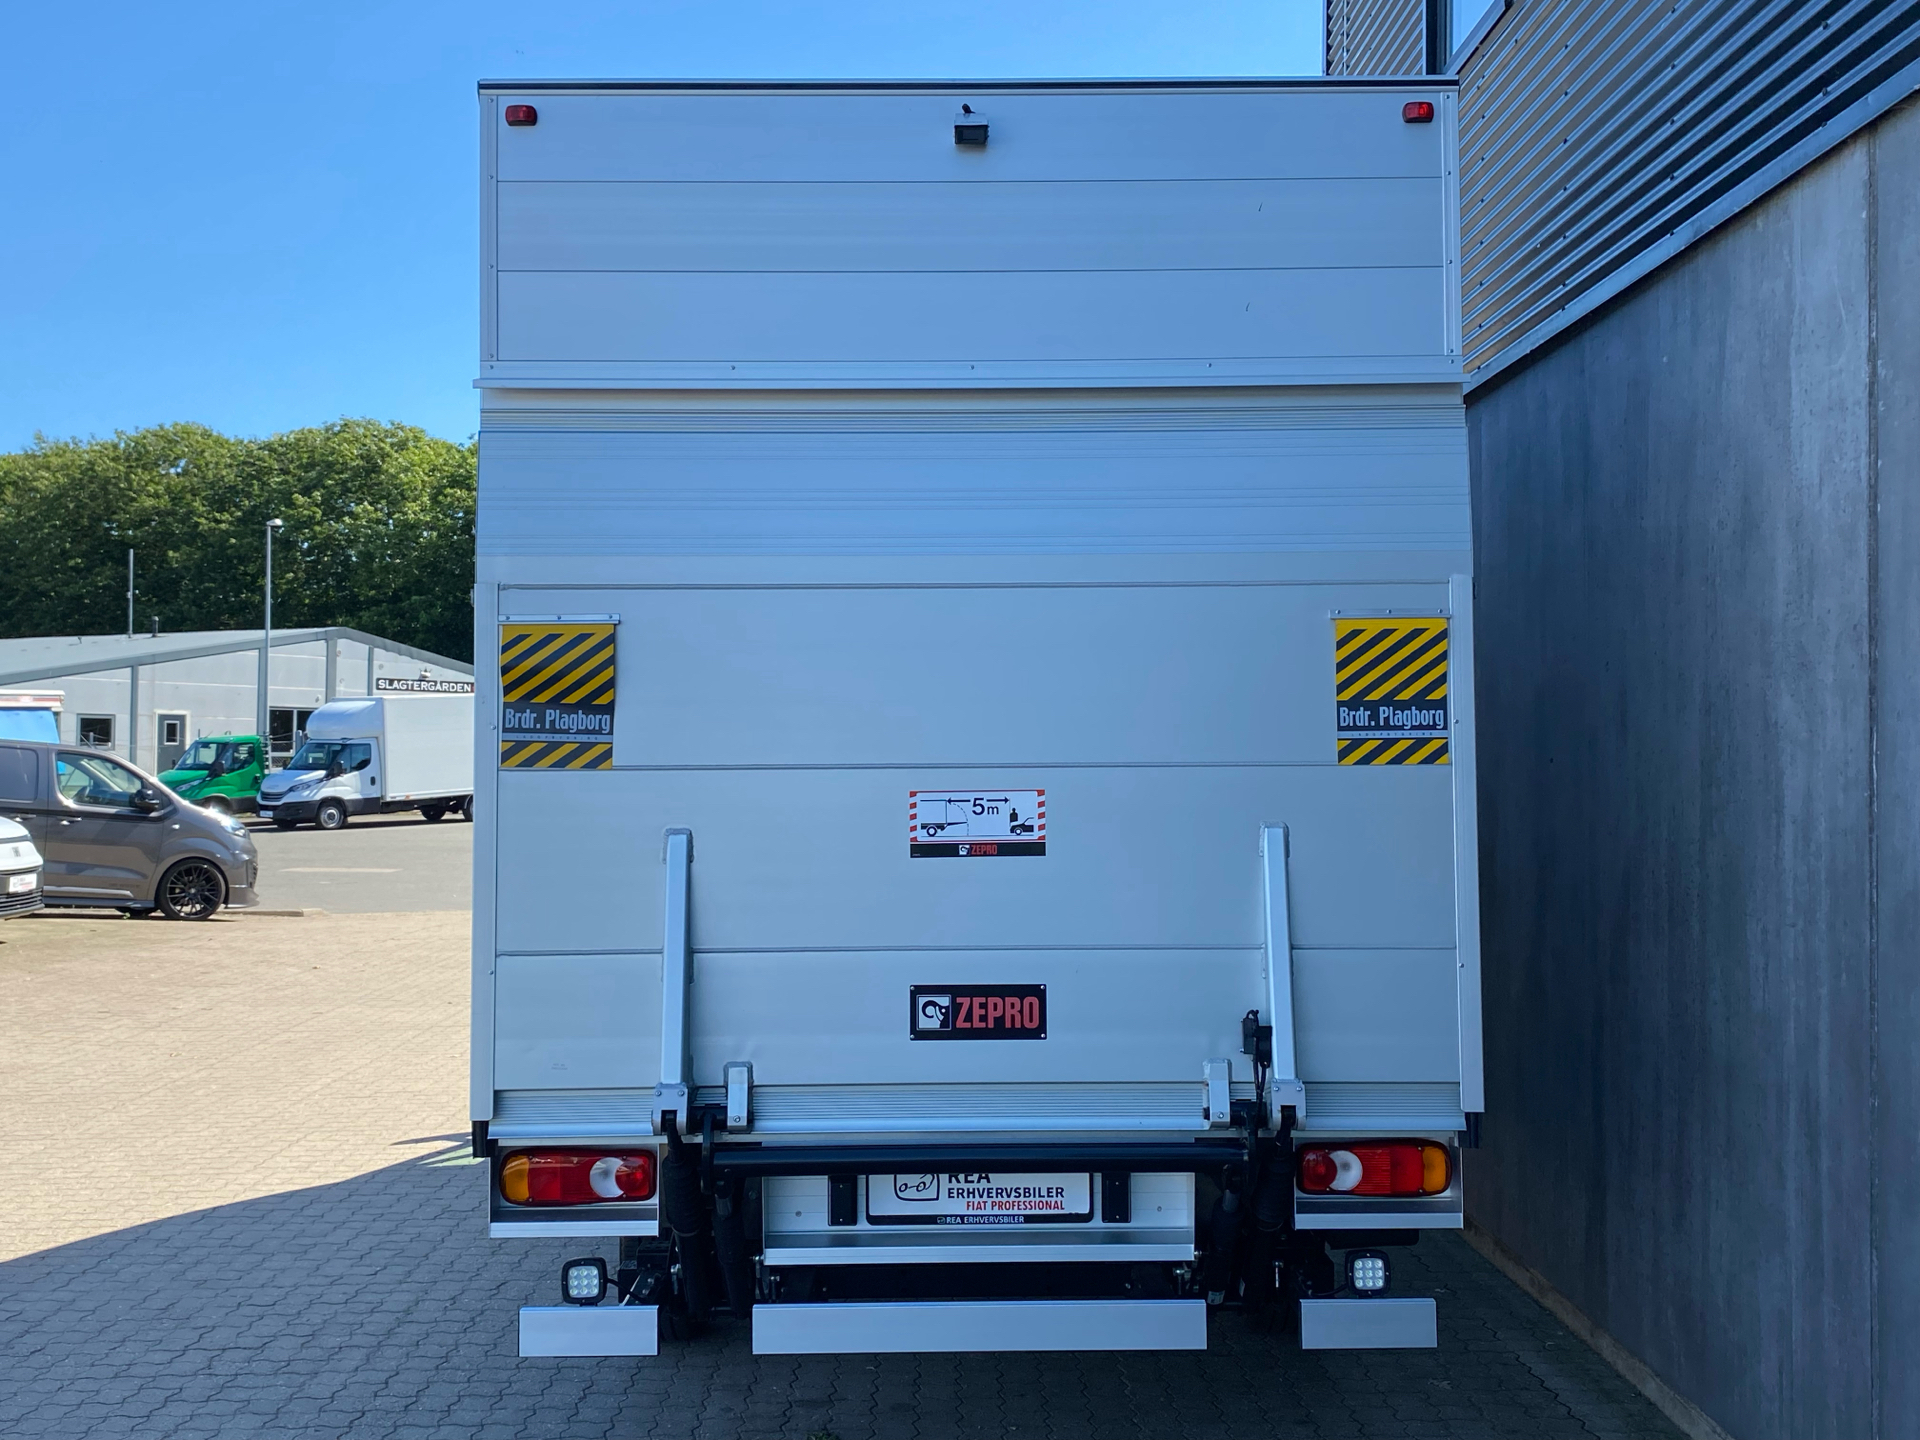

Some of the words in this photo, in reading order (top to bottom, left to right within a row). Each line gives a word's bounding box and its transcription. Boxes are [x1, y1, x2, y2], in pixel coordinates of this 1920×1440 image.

[378, 679, 471, 692] SLAGTERGÅRDEN
[505, 708, 541, 729] Brdr.
[545, 709, 611, 734] Plagborg
[1339, 706, 1375, 727] Brdr.
[1379, 706, 1444, 729] Plagborg
[971, 844, 998, 855] ZEPRO
[955, 996, 1040, 1029] ZEPRO
[948, 1173, 991, 1184] REA
[947, 1186, 1065, 1199] ERHVERVSBILER
[966, 1200, 988, 1211] FIAT
[990, 1200, 1065, 1211] PROFESSIONAL
[946, 1216, 962, 1224] REA
[964, 1215, 1025, 1224] ERHVERVSBILER
